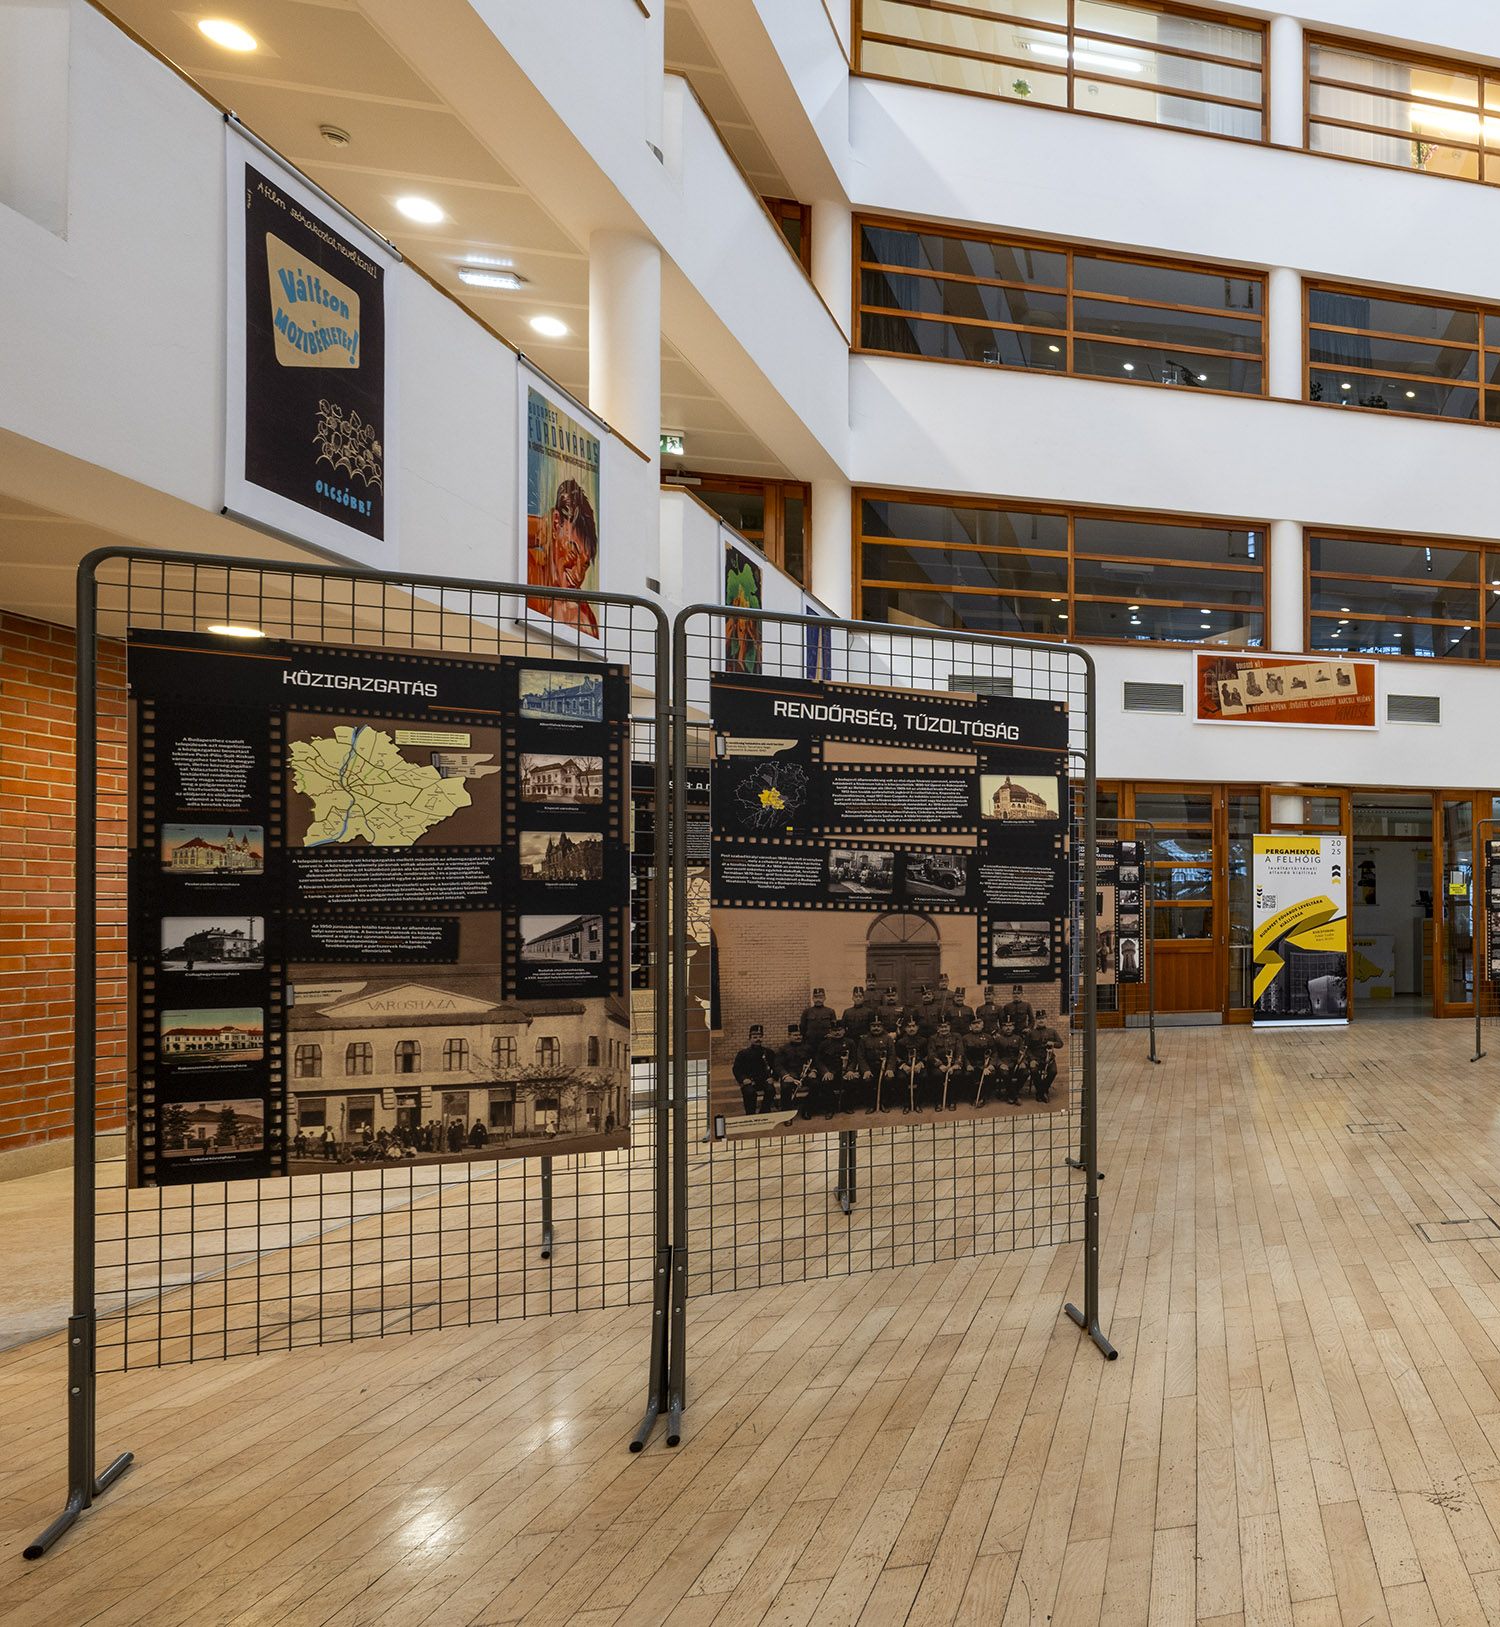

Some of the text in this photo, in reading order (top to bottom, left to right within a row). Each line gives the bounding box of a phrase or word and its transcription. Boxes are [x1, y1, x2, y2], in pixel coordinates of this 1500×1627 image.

[277, 268, 350, 320] Váltson
[315, 480, 372, 516] OLCSÓBB!
[283, 670, 438, 697] KÖZIGAZGATÁS
[773, 701, 1019, 740] RENDŐRSÉG, TŰZOLTÓSÁG
